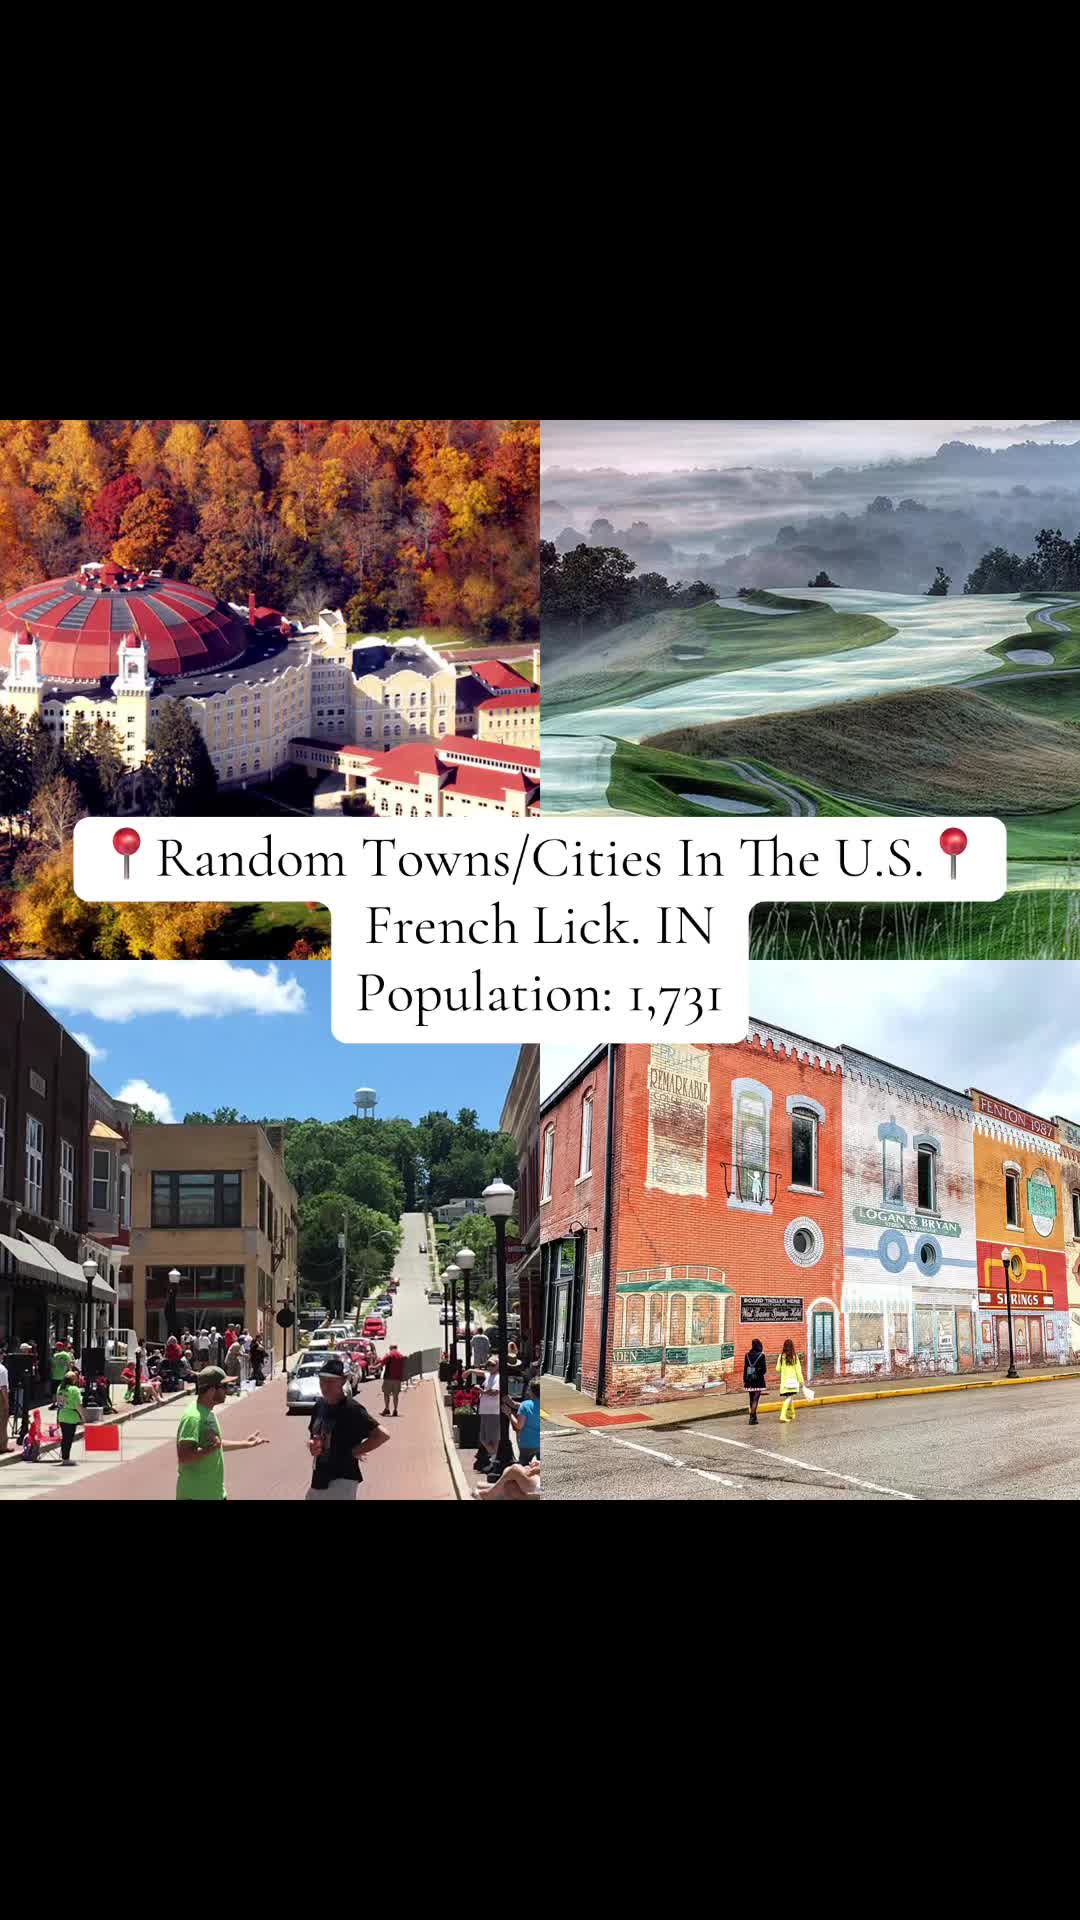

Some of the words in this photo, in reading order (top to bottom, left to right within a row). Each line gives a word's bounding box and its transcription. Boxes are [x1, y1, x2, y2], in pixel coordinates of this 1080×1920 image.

[650, 1068, 708, 1102] REMARKABLE
[981, 1098, 1025, 1127] FENTON
[1031, 1120, 1052, 1137] 1987
[860, 1208, 905, 1223] LOGAN
[908, 1215, 918, 1226] &
[922, 1218, 957, 1231] BRYAN
